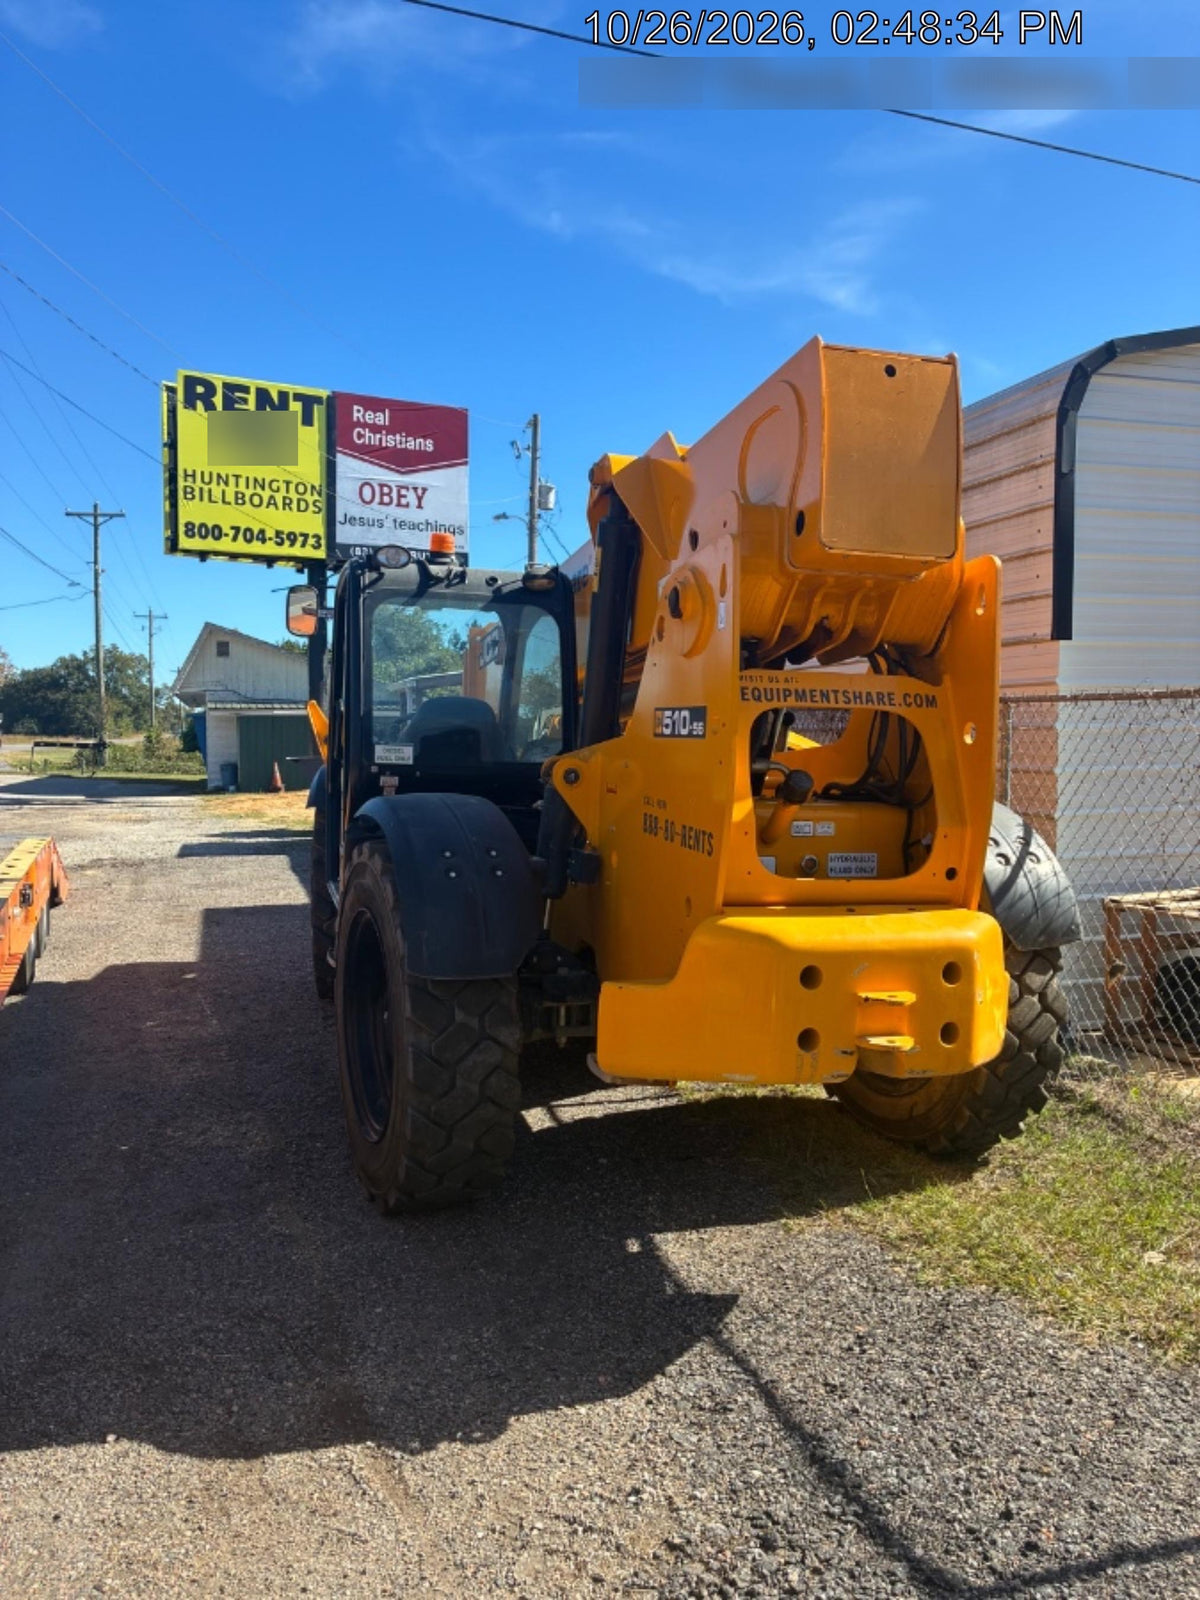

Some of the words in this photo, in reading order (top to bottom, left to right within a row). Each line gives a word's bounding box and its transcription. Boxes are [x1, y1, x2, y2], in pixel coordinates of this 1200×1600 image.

[183, 375, 324, 427] RENT
[353, 405, 390, 426] Real
[353, 428, 435, 452] Christians
[183, 468, 323, 498] HUNTINGTON
[358, 481, 428, 509] OBEY
[183, 485, 323, 515] BILLBOARDS
[183, 521, 323, 550] 800-704-5973
[338, 512, 388, 528] Jesus'
[392, 516, 465, 536] teachings
[739, 686, 938, 709] EQUIPMENTSHARE.COM
